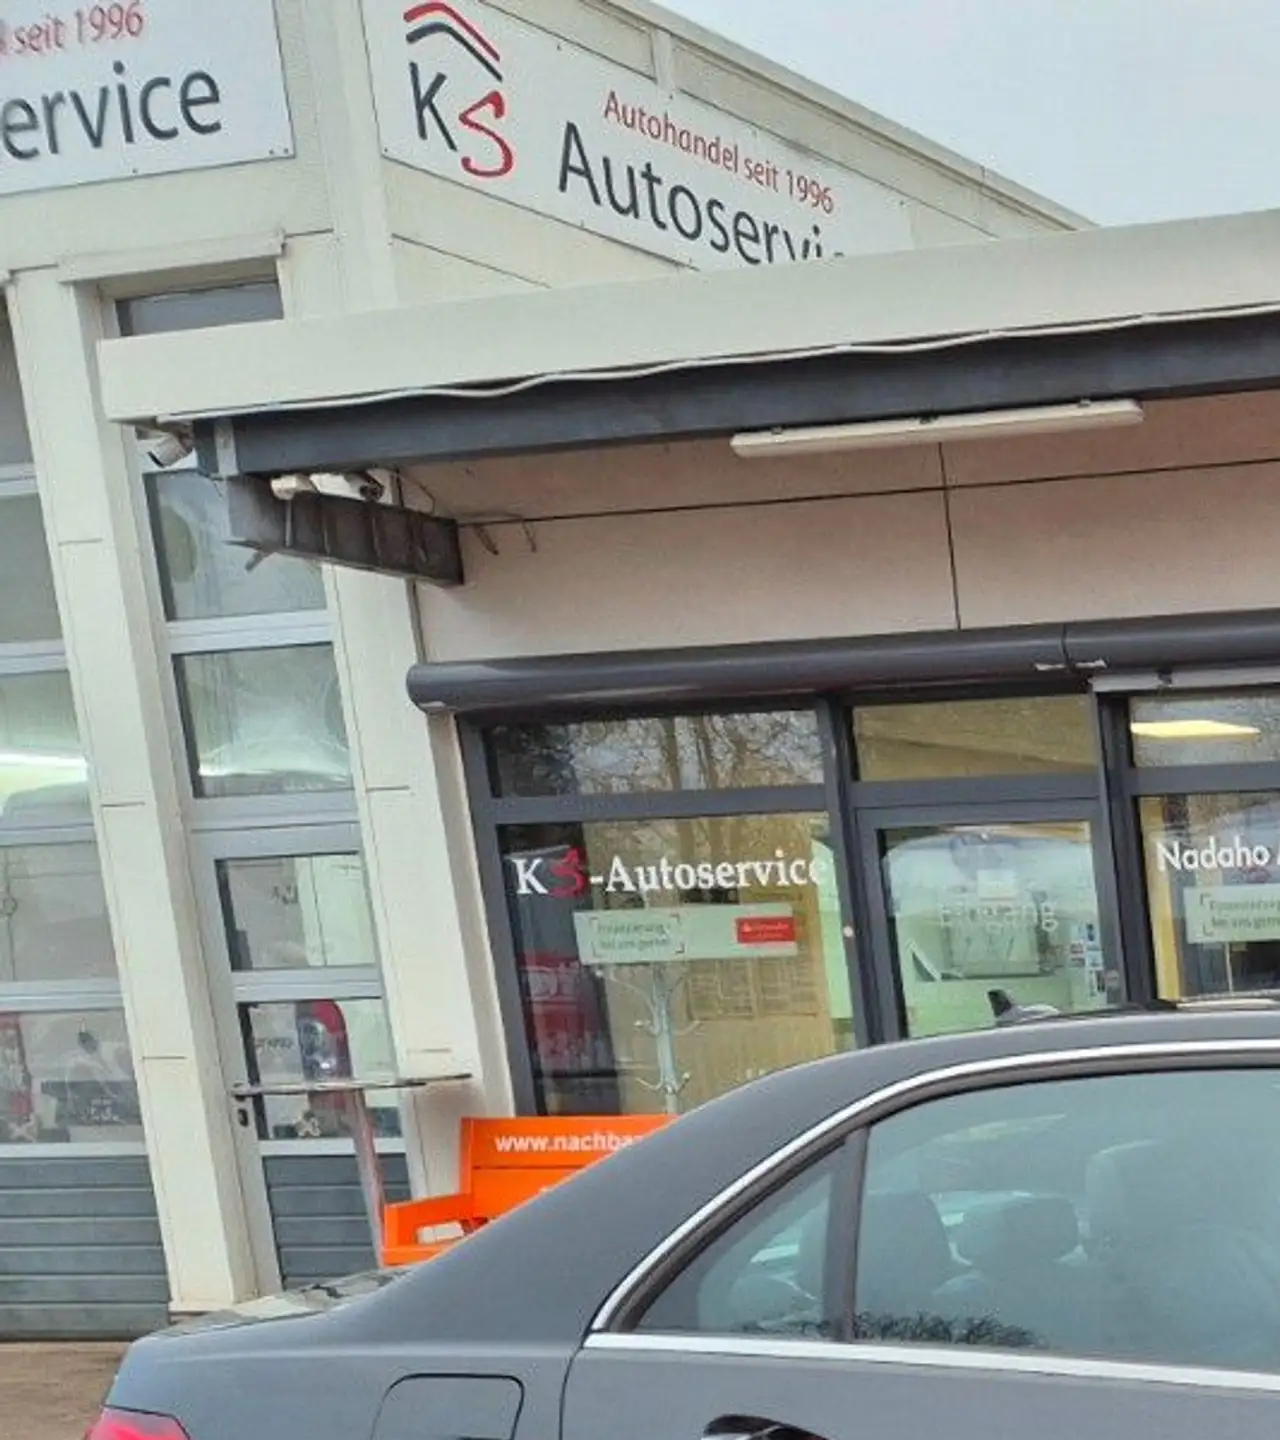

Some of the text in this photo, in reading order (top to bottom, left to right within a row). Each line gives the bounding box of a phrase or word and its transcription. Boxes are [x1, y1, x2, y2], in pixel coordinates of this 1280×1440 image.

[14, 15, 65, 54] seit
[74, 0, 144, 44] 1996
[604, 90, 834, 214] Autohandel seit 1996
[558, 120, 845, 266] Autoservi
[1156, 834, 1271, 871] Nadaho
[494, 1129, 645, 1152] www.nachba
